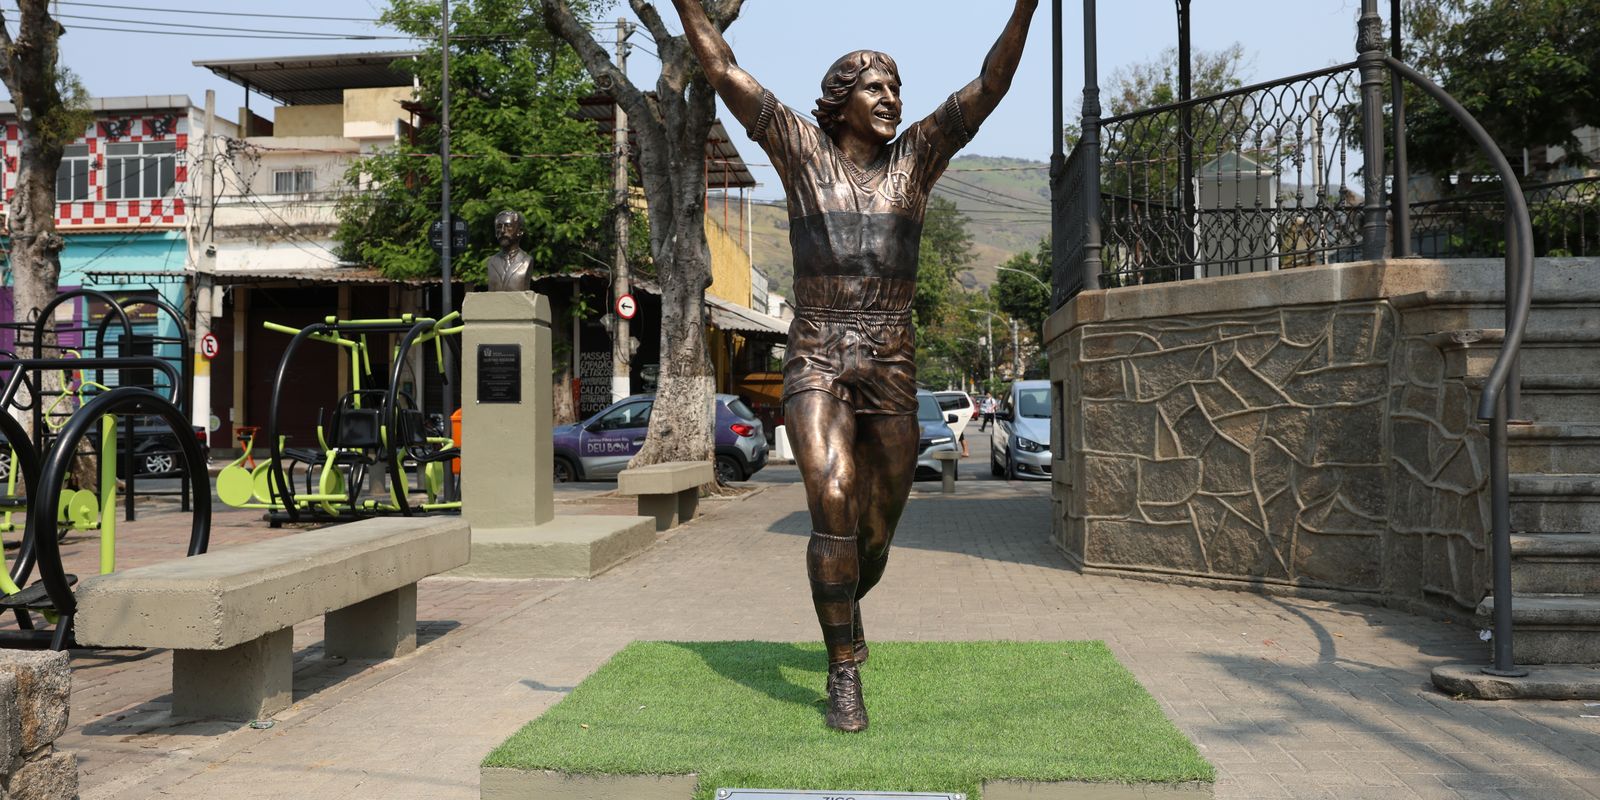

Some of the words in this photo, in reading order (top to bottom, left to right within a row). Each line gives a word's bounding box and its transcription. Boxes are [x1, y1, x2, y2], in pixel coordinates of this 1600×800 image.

[580, 352, 611, 360] MASSAS
[580, 385, 612, 395] CALDOS
[588, 443, 606, 453] DEU
[607, 442, 630, 453] BOM
